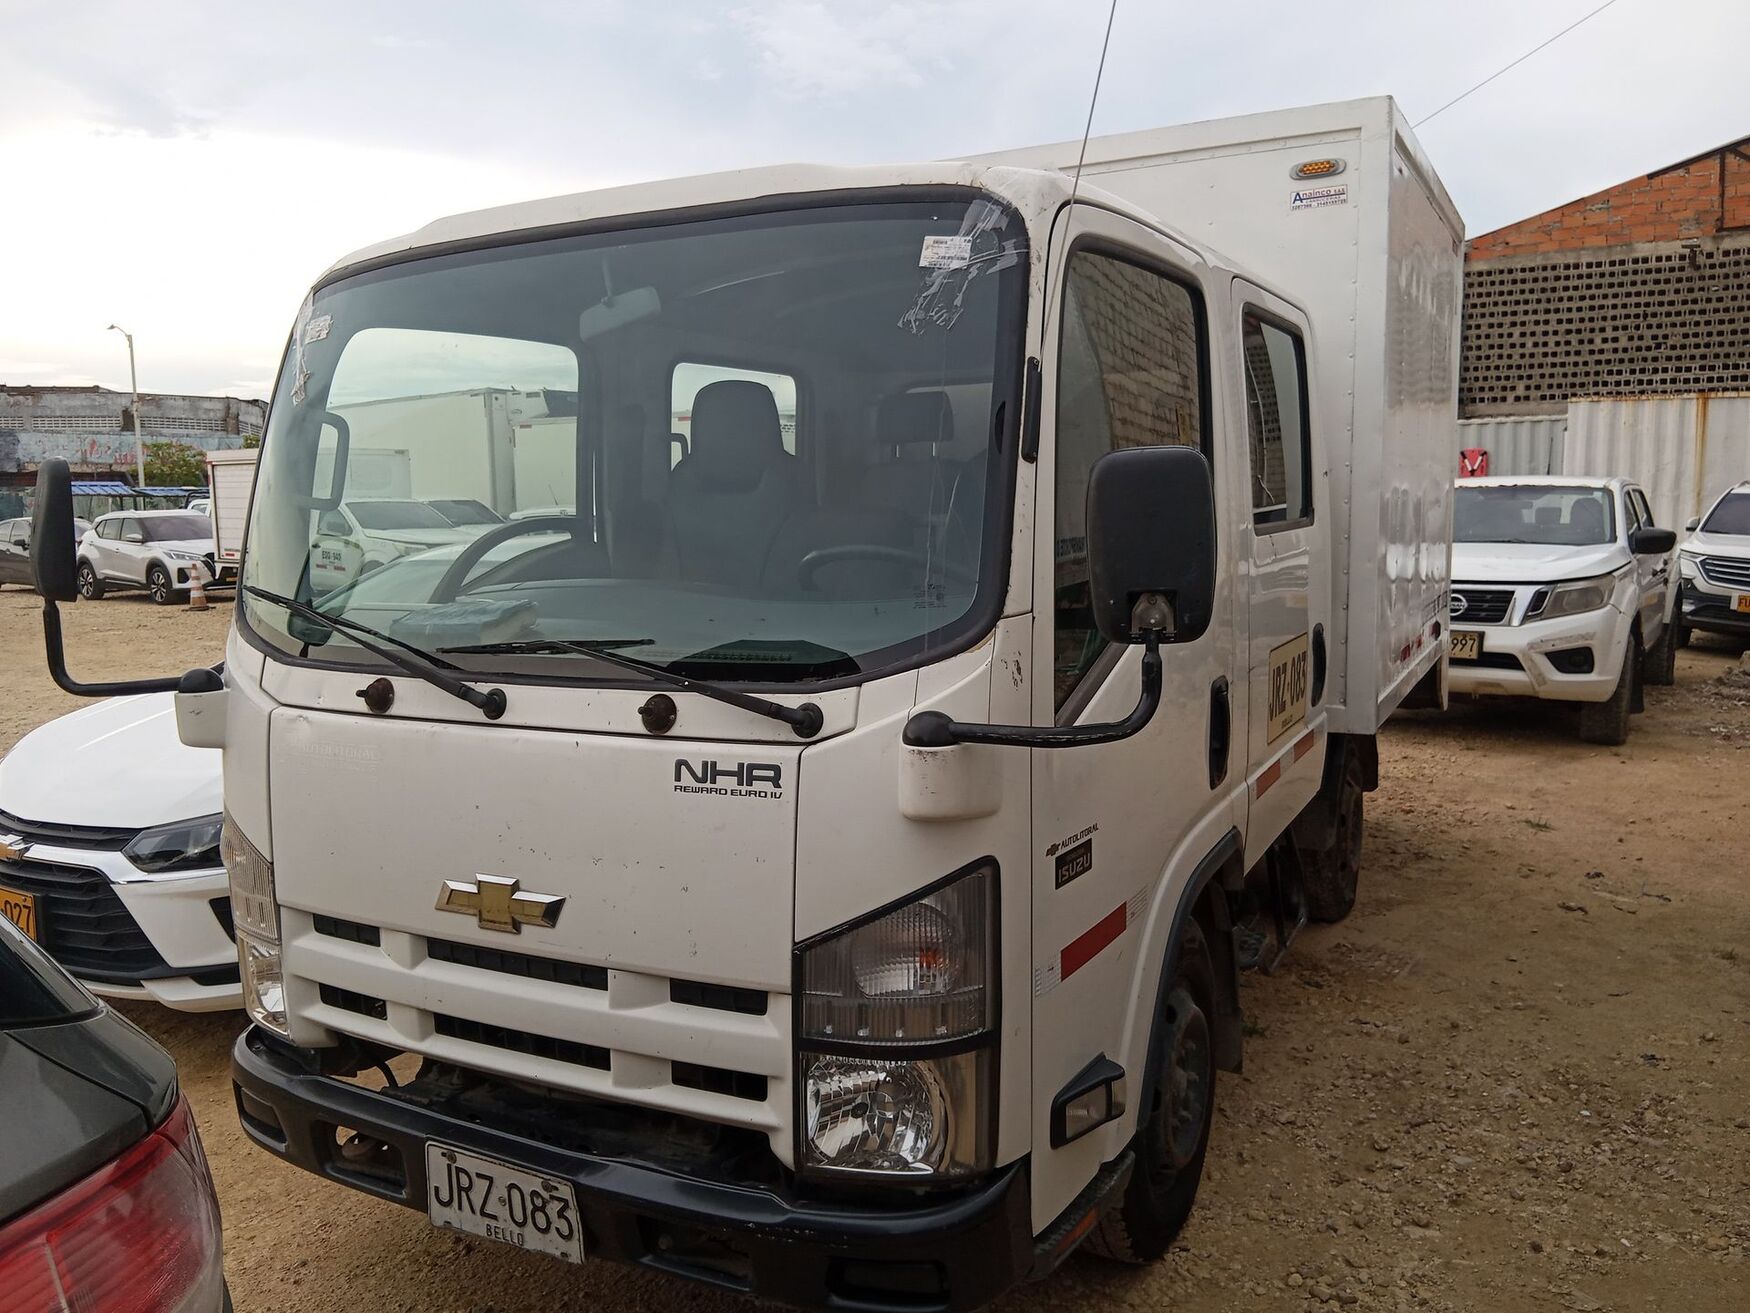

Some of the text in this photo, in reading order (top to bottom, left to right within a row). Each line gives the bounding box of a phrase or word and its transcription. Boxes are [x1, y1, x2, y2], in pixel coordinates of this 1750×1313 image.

[1451, 636, 1476, 653] 997
[674, 758, 783, 789] NHR
[673, 785, 782, 799] REWARD EURO IV
[1061, 822, 1099, 850] AUTOLITORAL
[1058, 852, 1091, 883] ISUZU
[485, 1223, 524, 1247] BELLO
